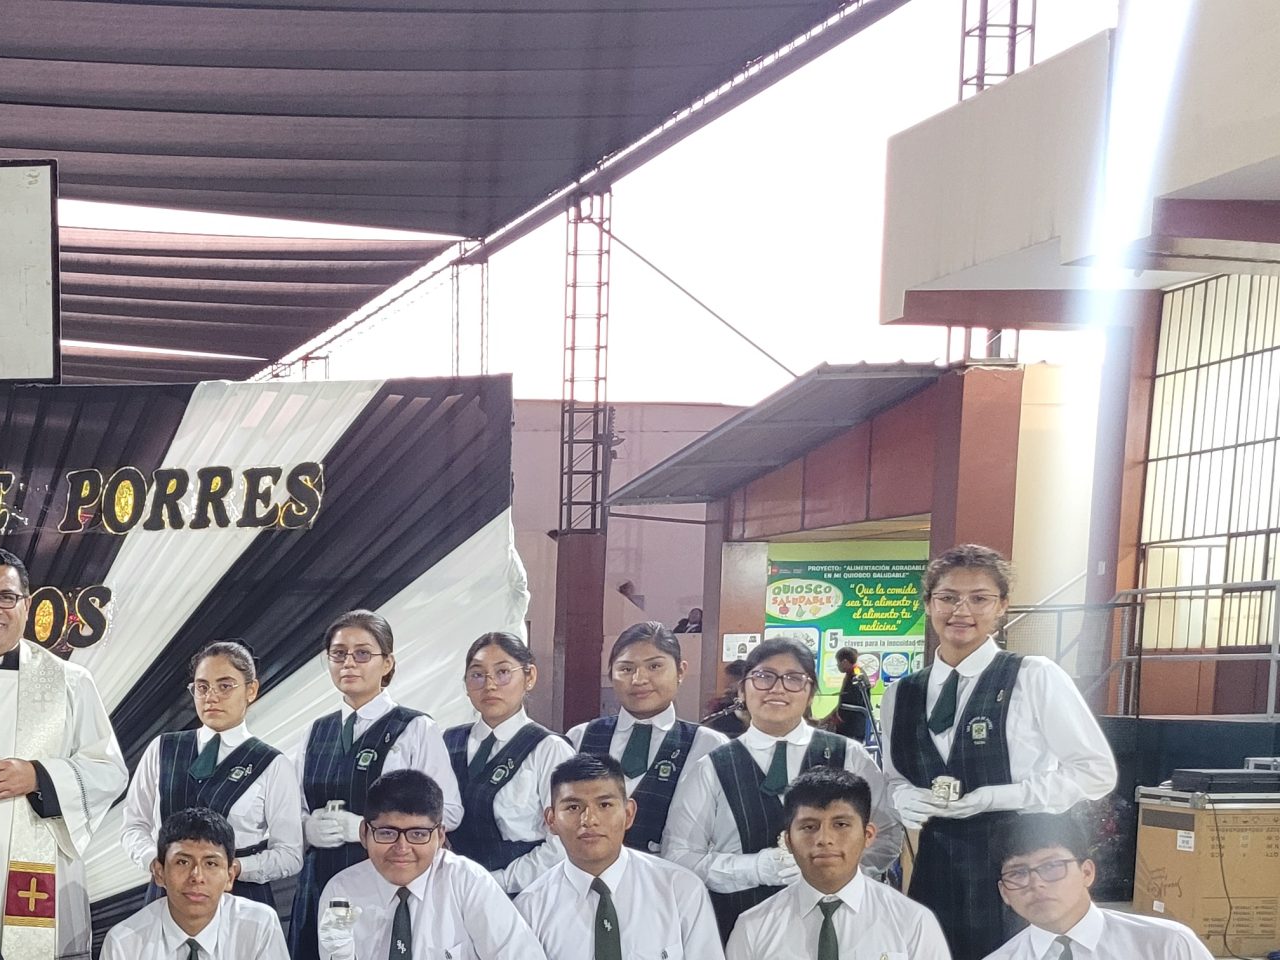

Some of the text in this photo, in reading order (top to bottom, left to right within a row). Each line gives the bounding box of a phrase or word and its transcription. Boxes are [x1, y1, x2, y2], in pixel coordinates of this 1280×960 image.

[58, 462, 324, 534] PORRES
[772, 584, 833, 596] QUIOSCO
[875, 583, 886, 594] la
[886, 583, 918, 594] comida
[771, 595, 832, 606] SALUDABLE
[845, 595, 920, 611] sea tu alimento y
[852, 607, 912, 619] el alimento tu
[828, 632, 839, 649] 5
[844, 639, 864, 647] claves
[865, 640, 878, 648] para
[879, 639, 886, 647] la
